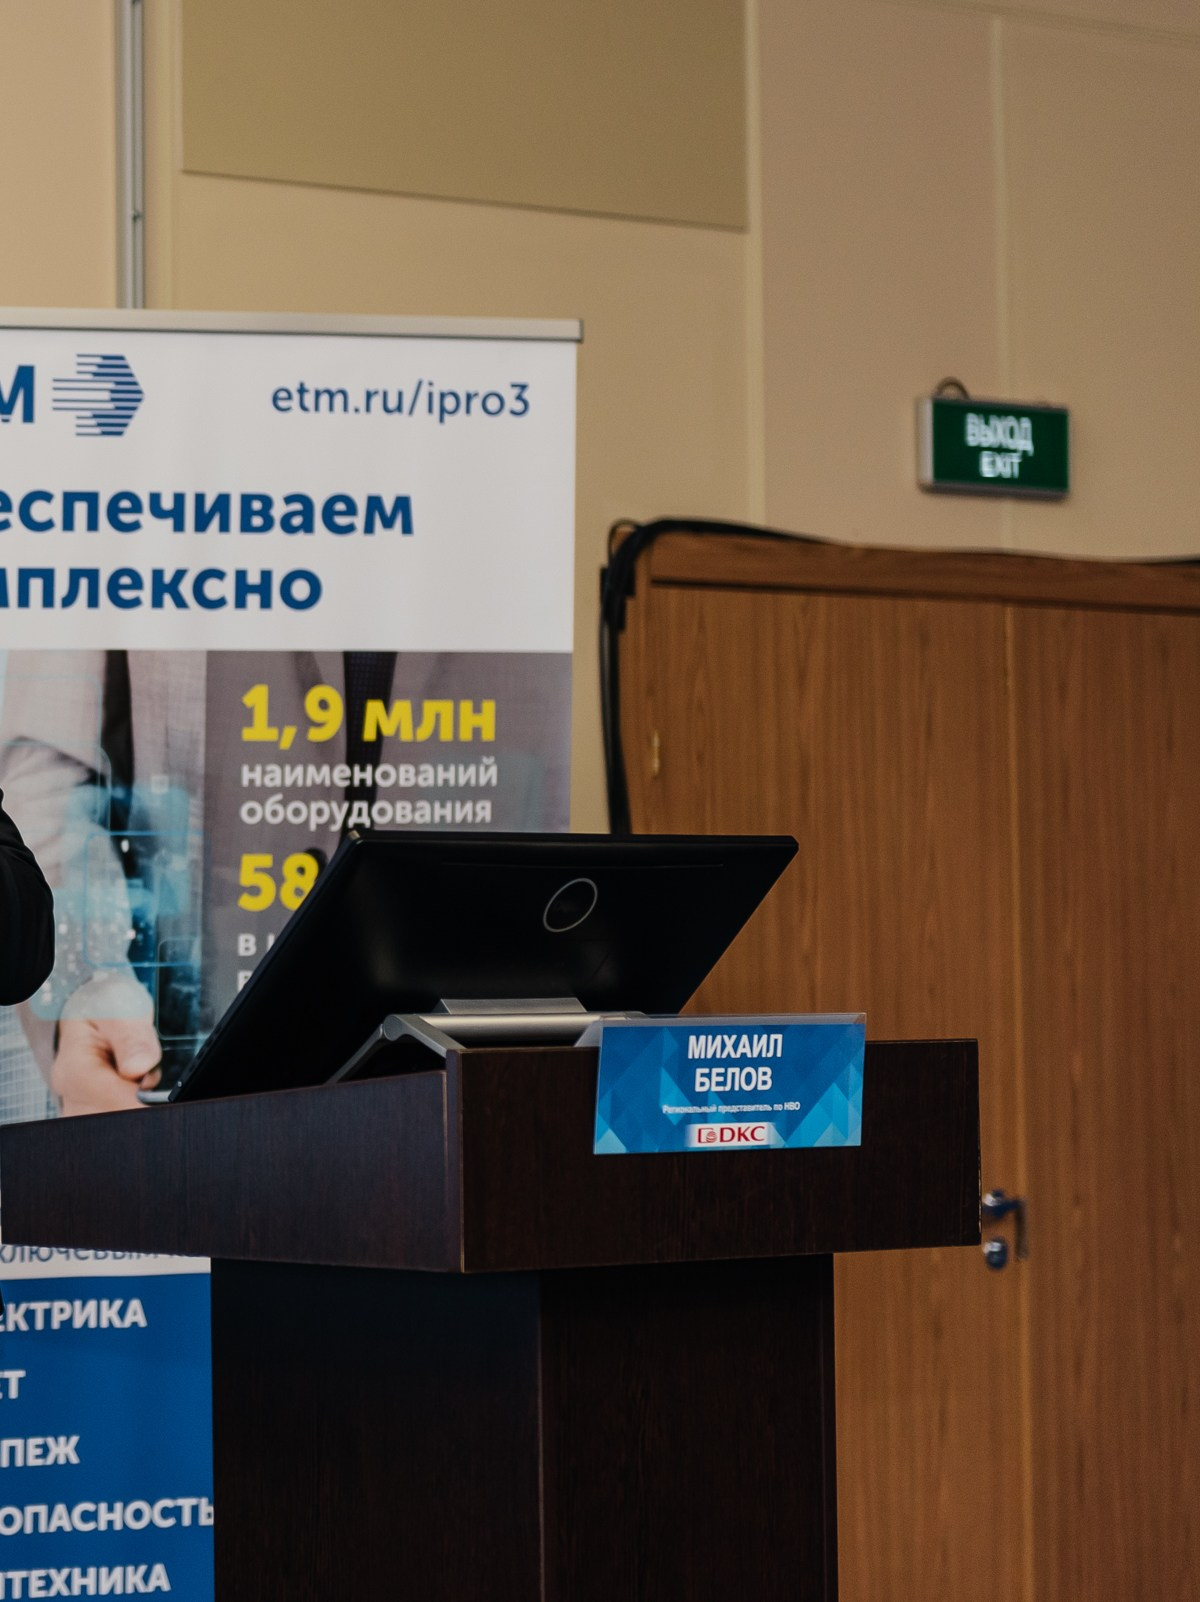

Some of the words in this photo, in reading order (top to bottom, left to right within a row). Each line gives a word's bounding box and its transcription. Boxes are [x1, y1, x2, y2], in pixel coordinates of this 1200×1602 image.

[272, 379, 531, 424] etm.ru/ipro3
[965, 412, 1034, 457] ВЫХОД
[979, 450, 1022, 478] EXIT
[241, 684, 344, 750] 1,9
[362, 699, 497, 743] млн
[241, 756, 498, 788] наименований
[240, 793, 493, 832] оборудования
[688, 1034, 783, 1060] МИХАИЛ
[695, 1066, 773, 1092] БЕЛОВ
